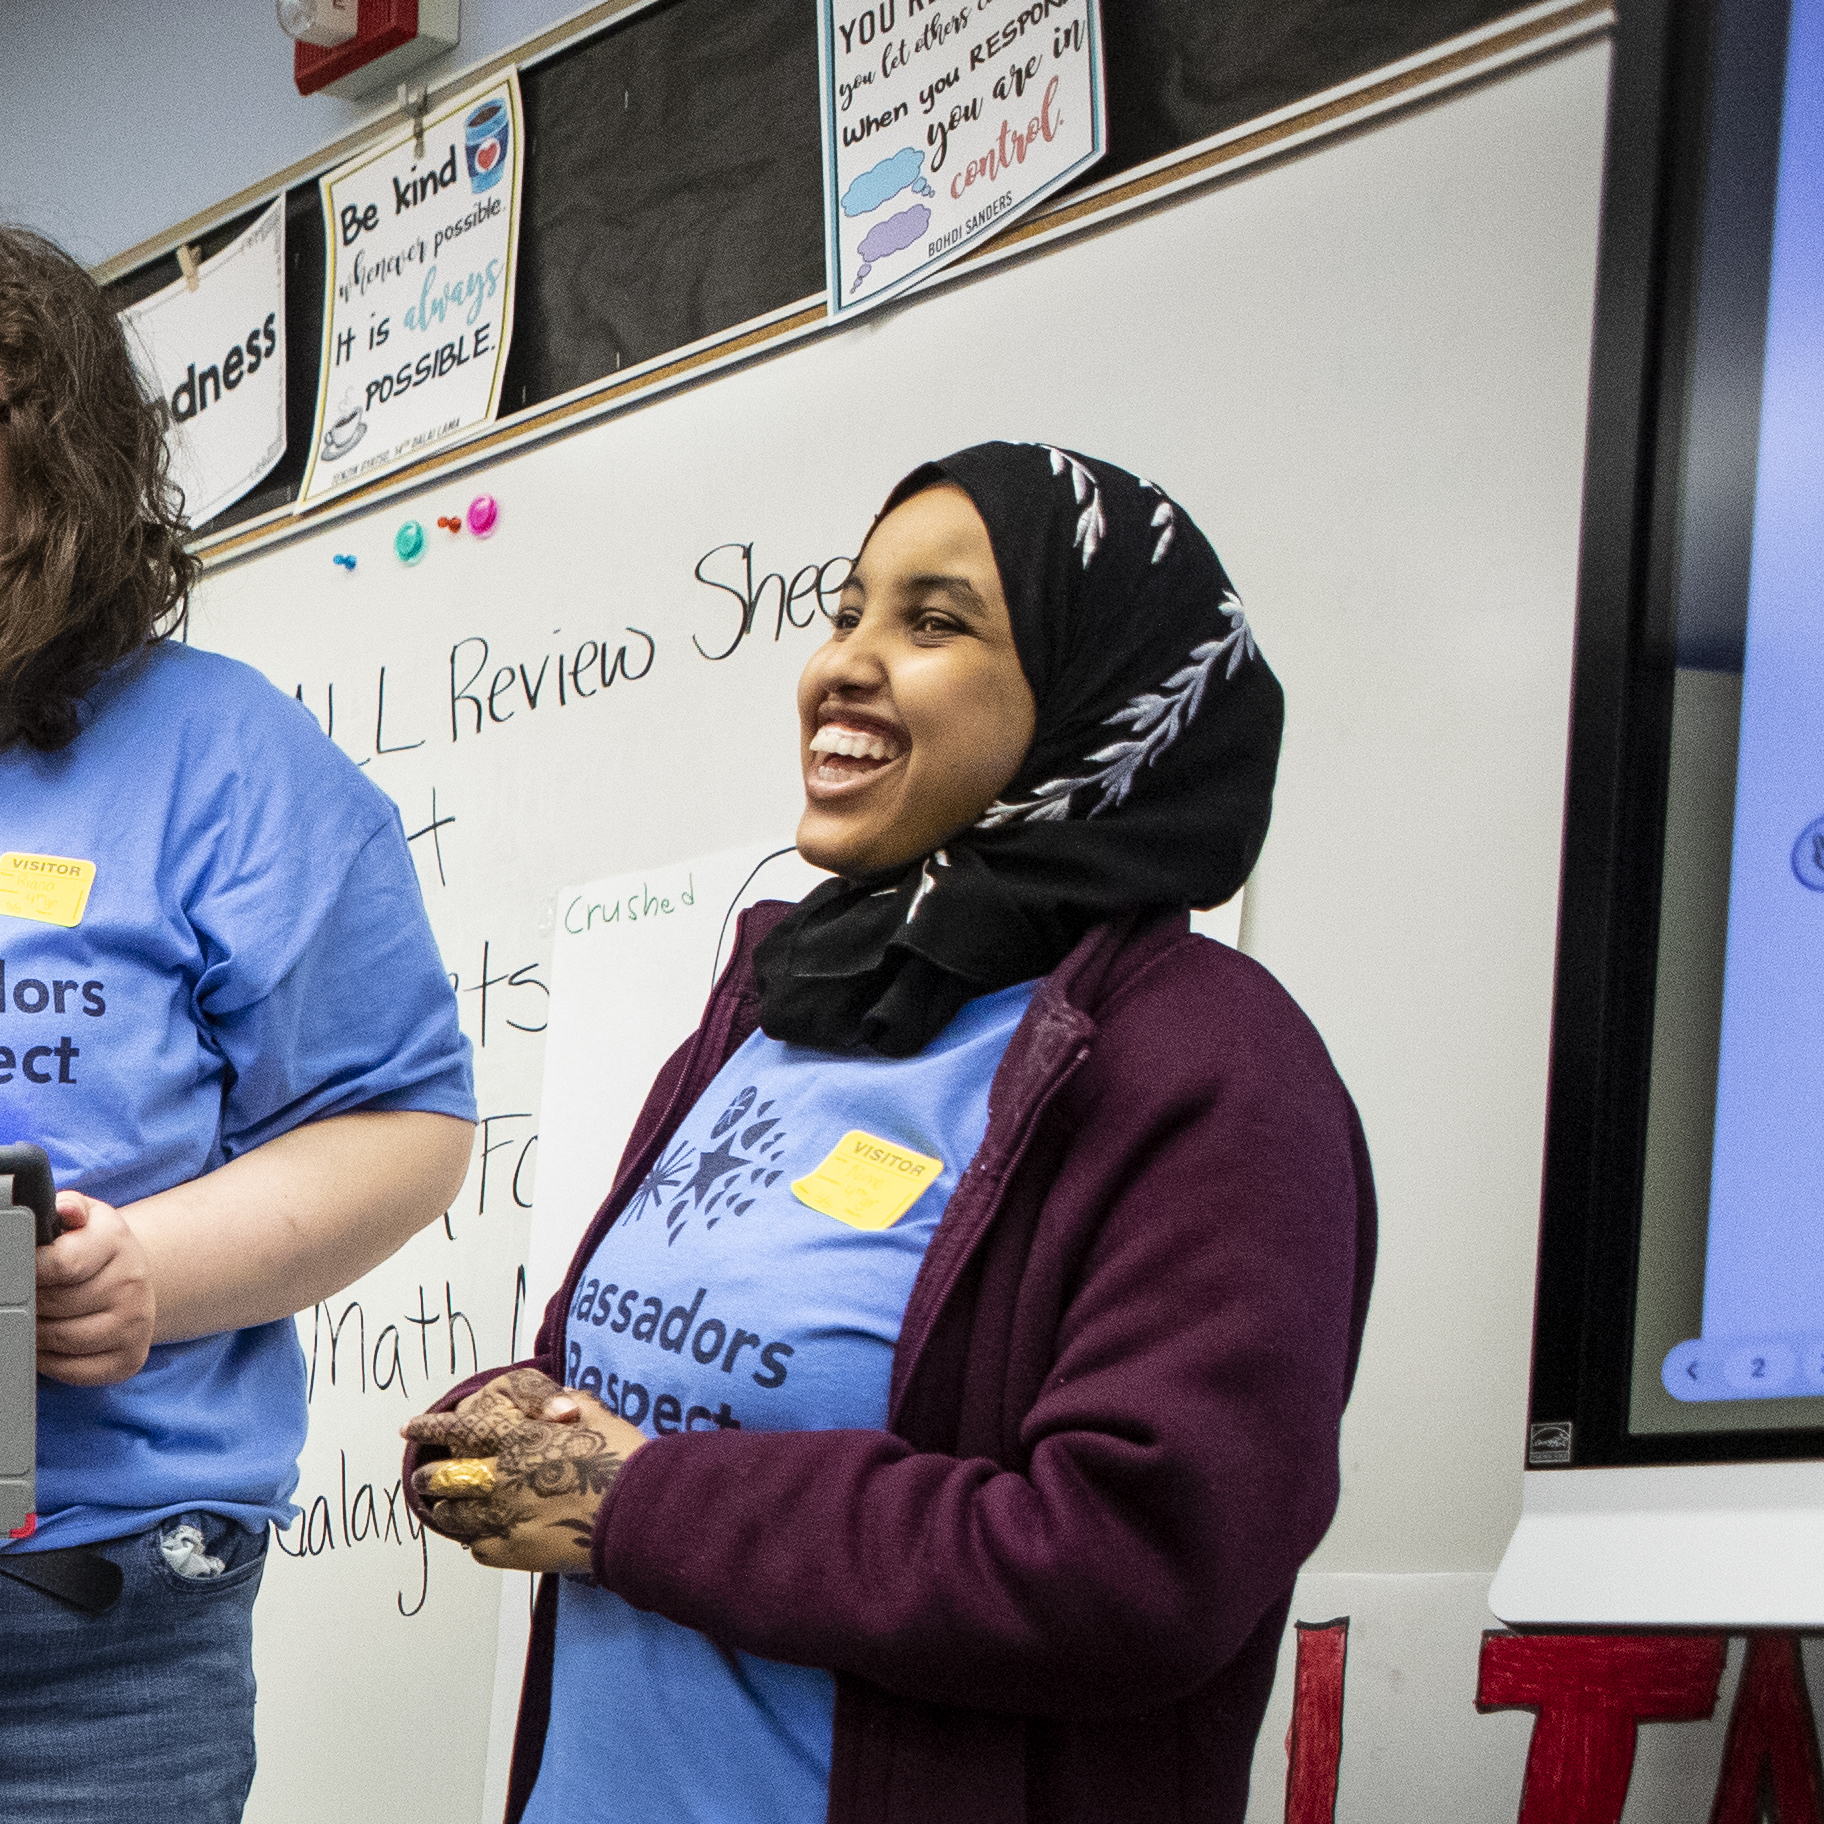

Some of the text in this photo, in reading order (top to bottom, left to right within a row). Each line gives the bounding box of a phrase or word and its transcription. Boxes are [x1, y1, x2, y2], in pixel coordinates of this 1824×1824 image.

[839, 0, 895, 54] YOU
[839, 70, 876, 111] you
[882, 39, 910, 78] let
[914, 8, 972, 53] others
[843, 100, 908, 147] When
[919, 67, 960, 114] you
[927, 19, 1085, 173] you are in
[950, 75, 1064, 200] control.
[340, 143, 457, 247] Be kind
[927, 190, 1013, 258] BOHDI SANDERS
[337, 236, 428, 304] whenever
[369, 311, 390, 351] is
[403, 257, 504, 331] always
[450, 626, 655, 743] Review
[12, 859, 82, 877] VISITOR
[563, 872, 696, 935] Crushed
[853, 1141, 926, 1178] VISITOR
[1751, 1357, 1765, 1379] 2
